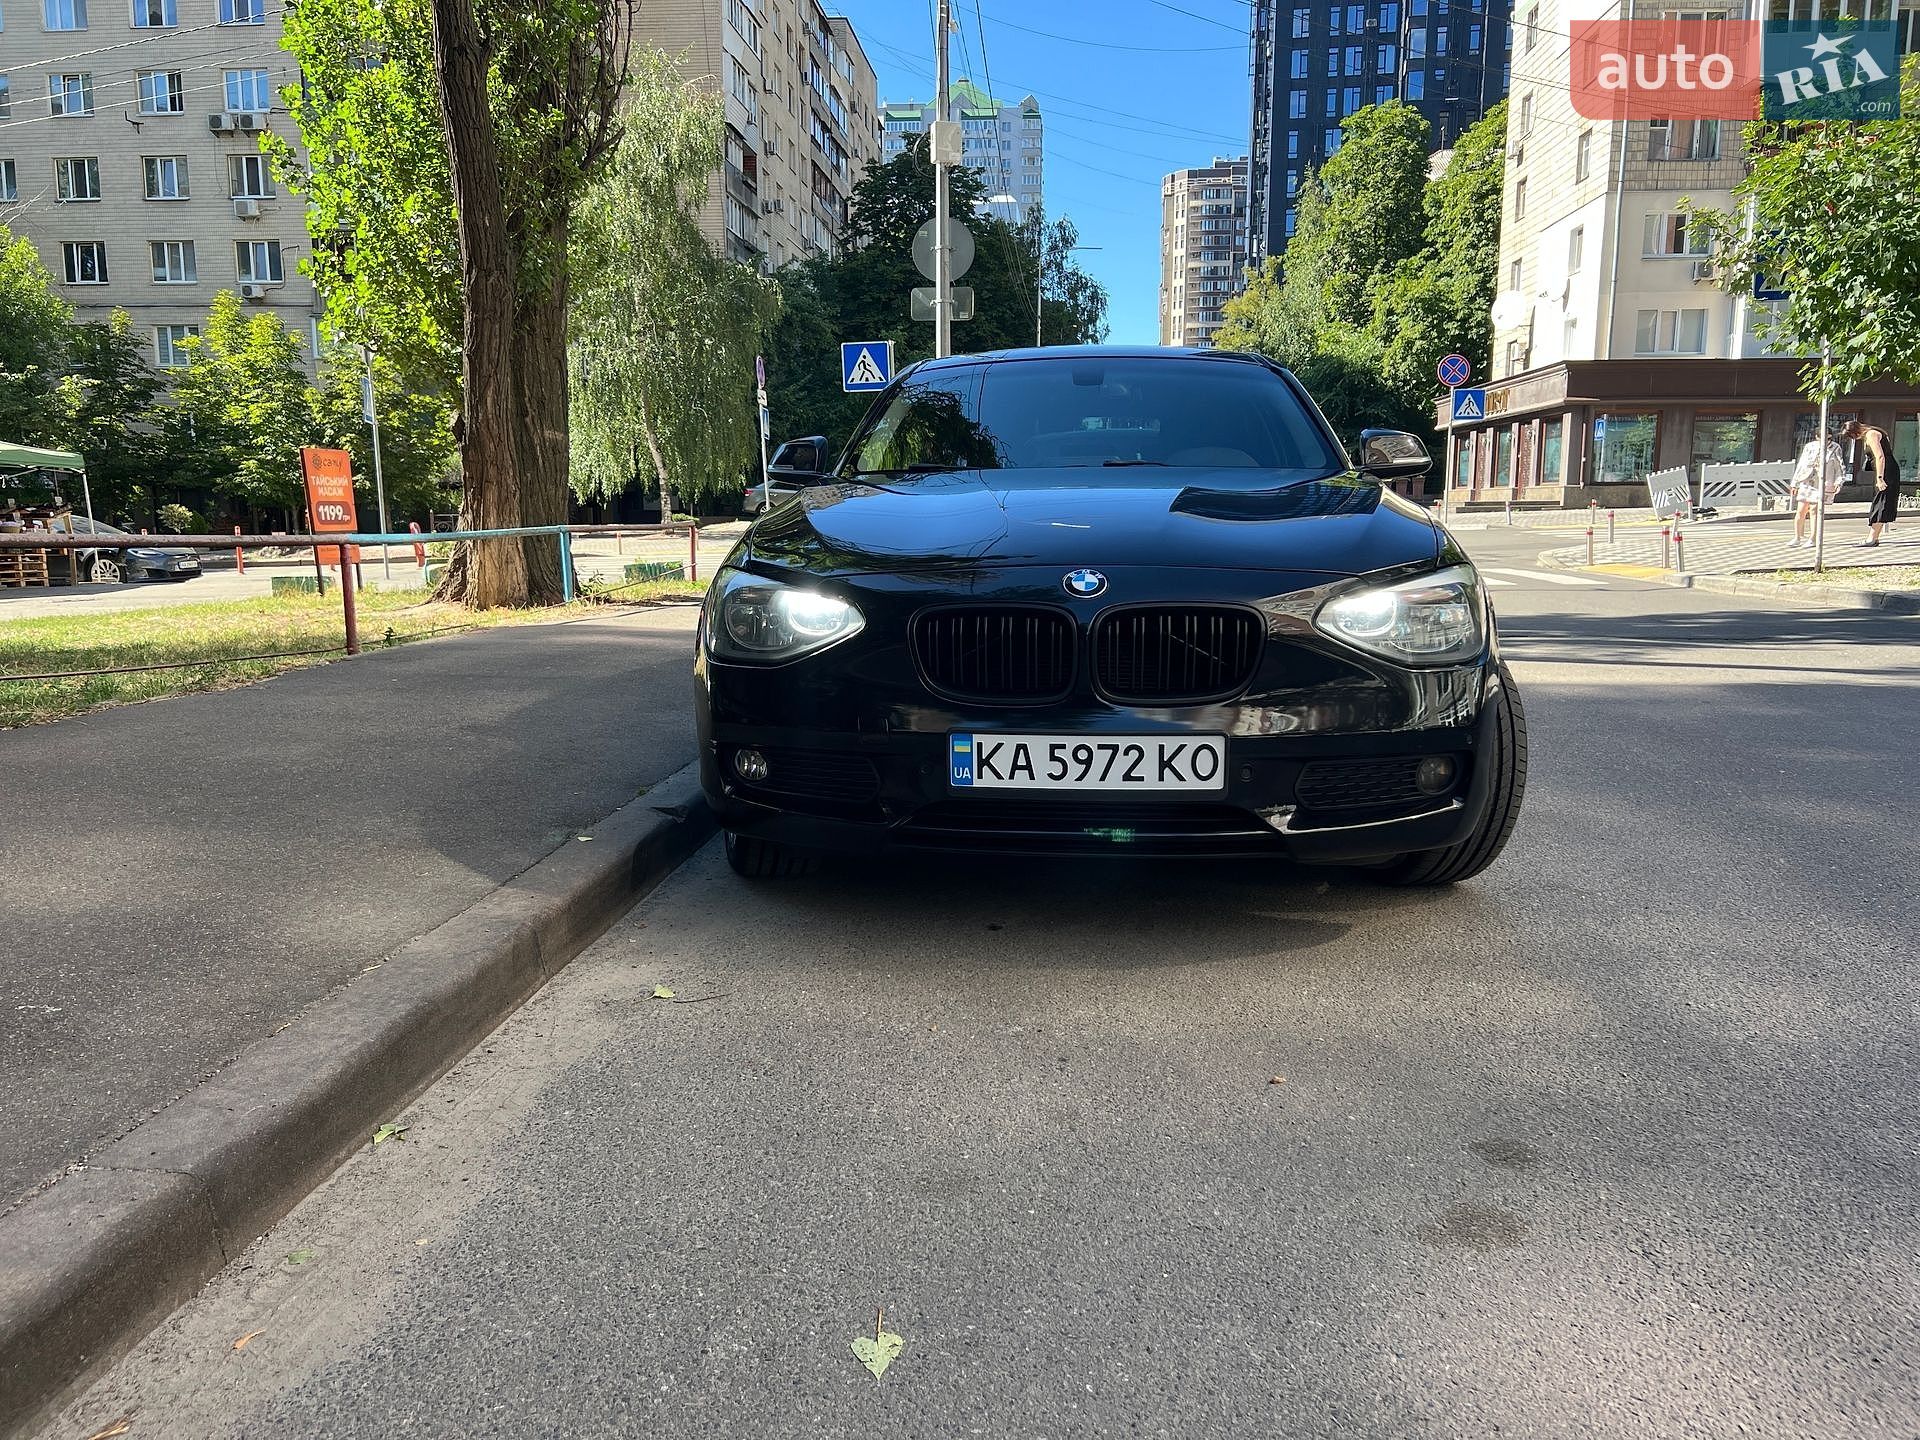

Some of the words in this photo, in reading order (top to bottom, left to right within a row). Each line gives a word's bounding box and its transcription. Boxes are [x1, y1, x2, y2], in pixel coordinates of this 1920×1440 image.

[311, 474, 349, 487] ТАЙСЬКИЙ
[318, 486, 345, 497] МАСАЖ
[319, 505, 343, 521] 1199
[976, 741, 1036, 781] KA
[1046, 743, 1146, 782] 5972
[1158, 743, 1219, 782] KO
[954, 767, 971, 779] UA
